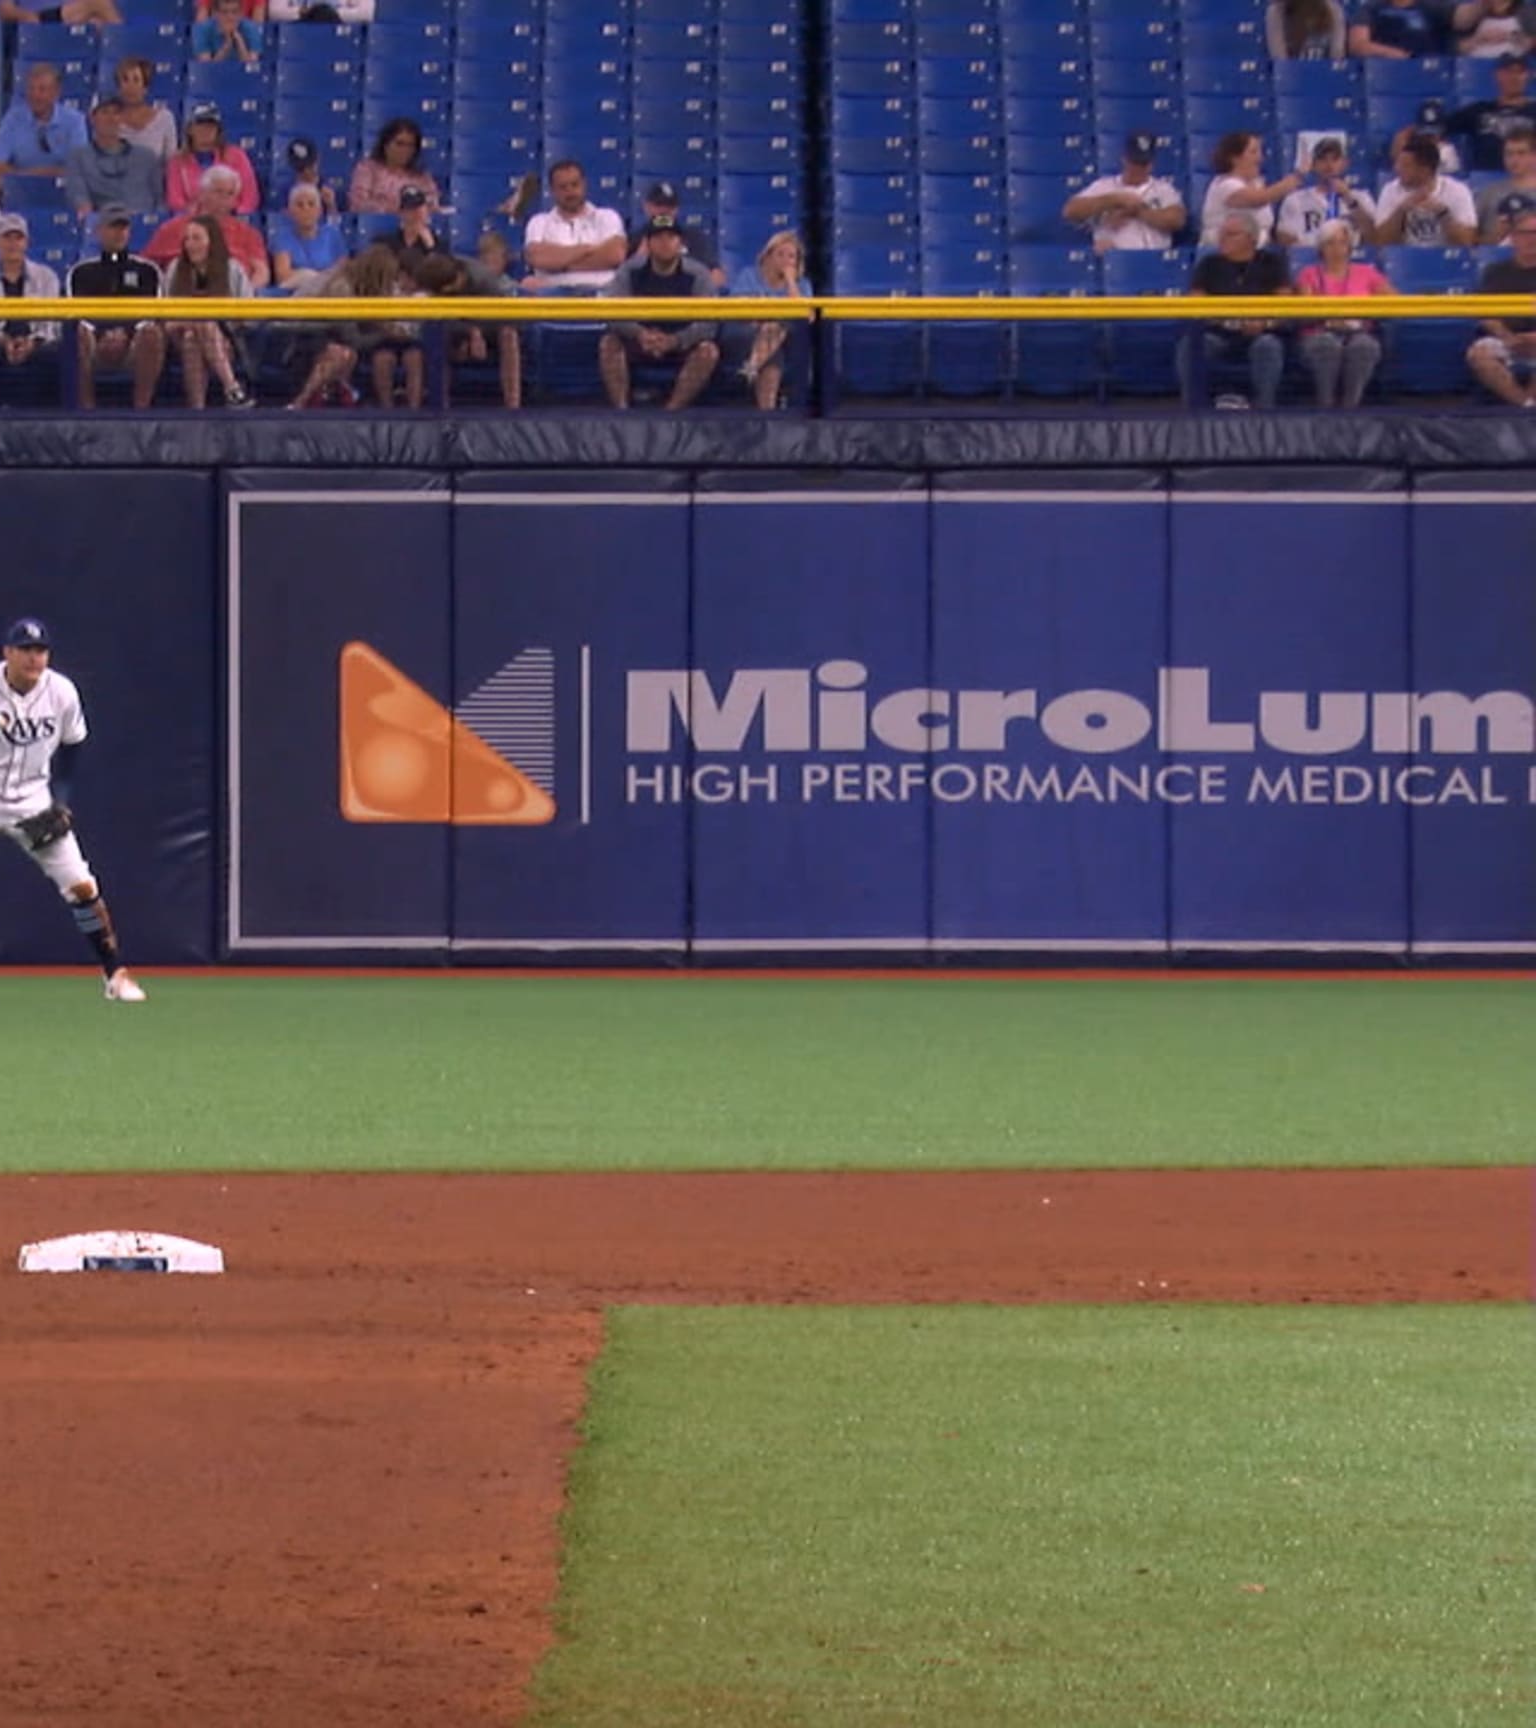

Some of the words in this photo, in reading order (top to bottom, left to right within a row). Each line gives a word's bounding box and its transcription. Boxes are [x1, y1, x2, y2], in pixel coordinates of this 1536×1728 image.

[625, 659, 1535, 754] MicroLum
[626, 764, 777, 803] HIGH
[802, 763, 1226, 804] PERFORMANCE
[1250, 764, 1508, 804] MEDICAL
